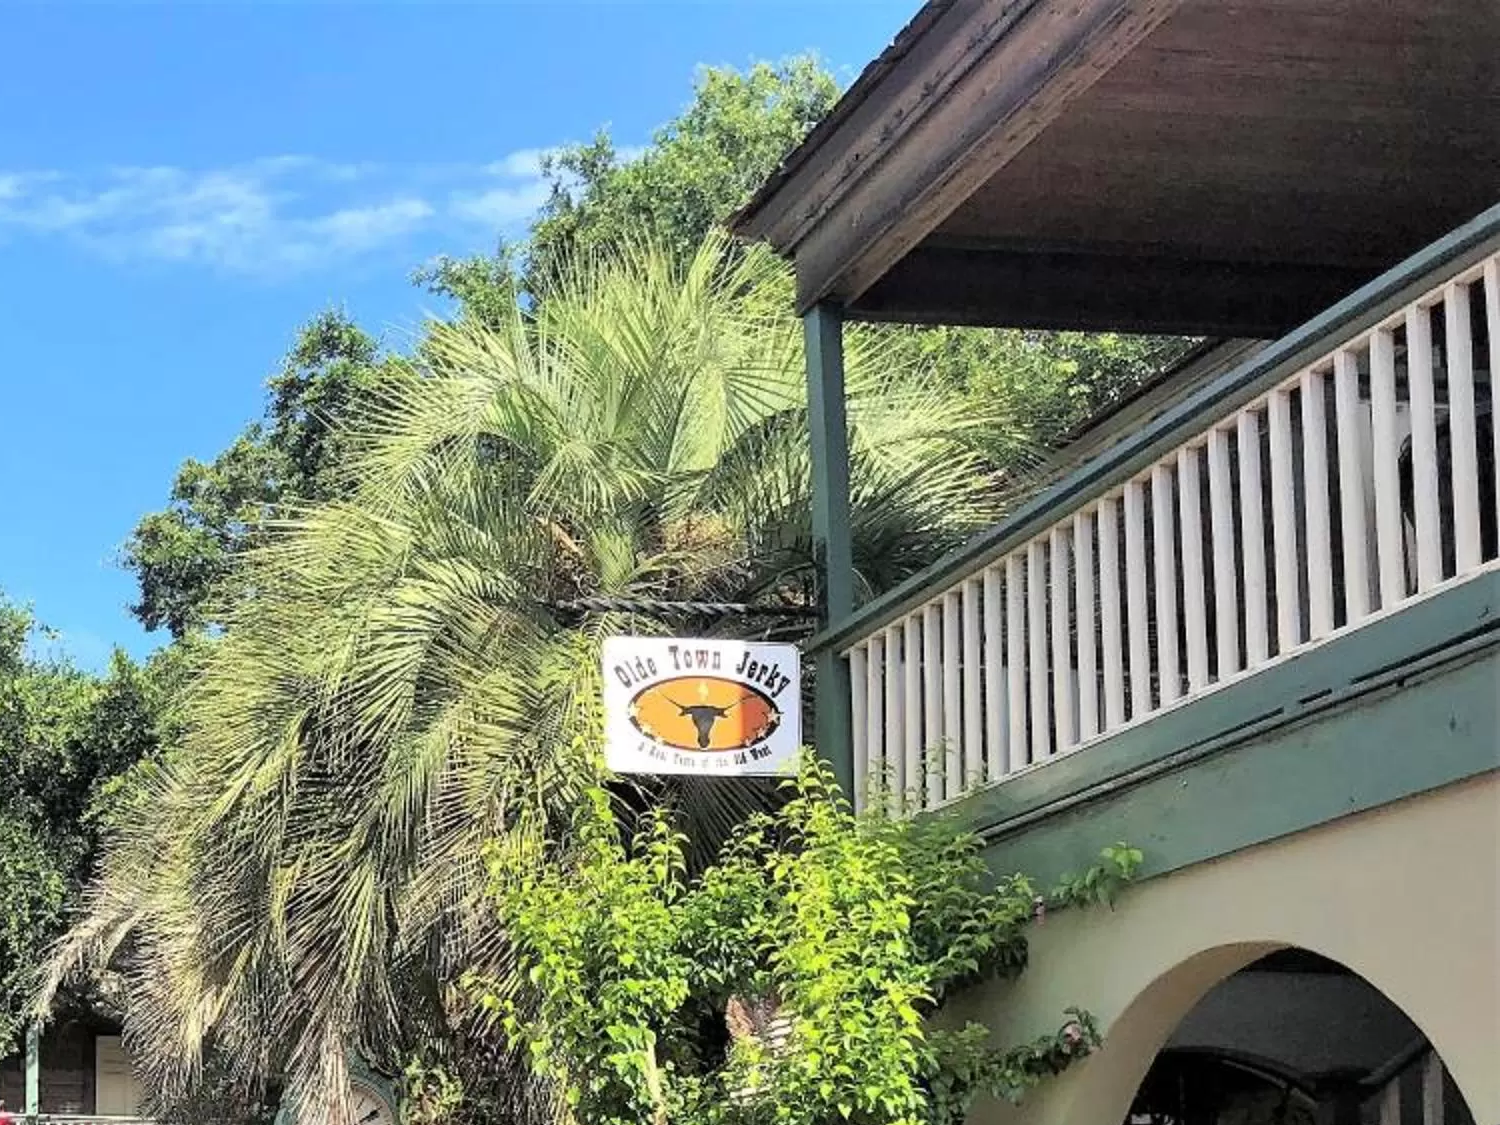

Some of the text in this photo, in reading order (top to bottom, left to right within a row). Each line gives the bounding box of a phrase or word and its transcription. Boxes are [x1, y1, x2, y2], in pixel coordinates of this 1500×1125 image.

[613, 645, 791, 698] Olde Town Jerky
